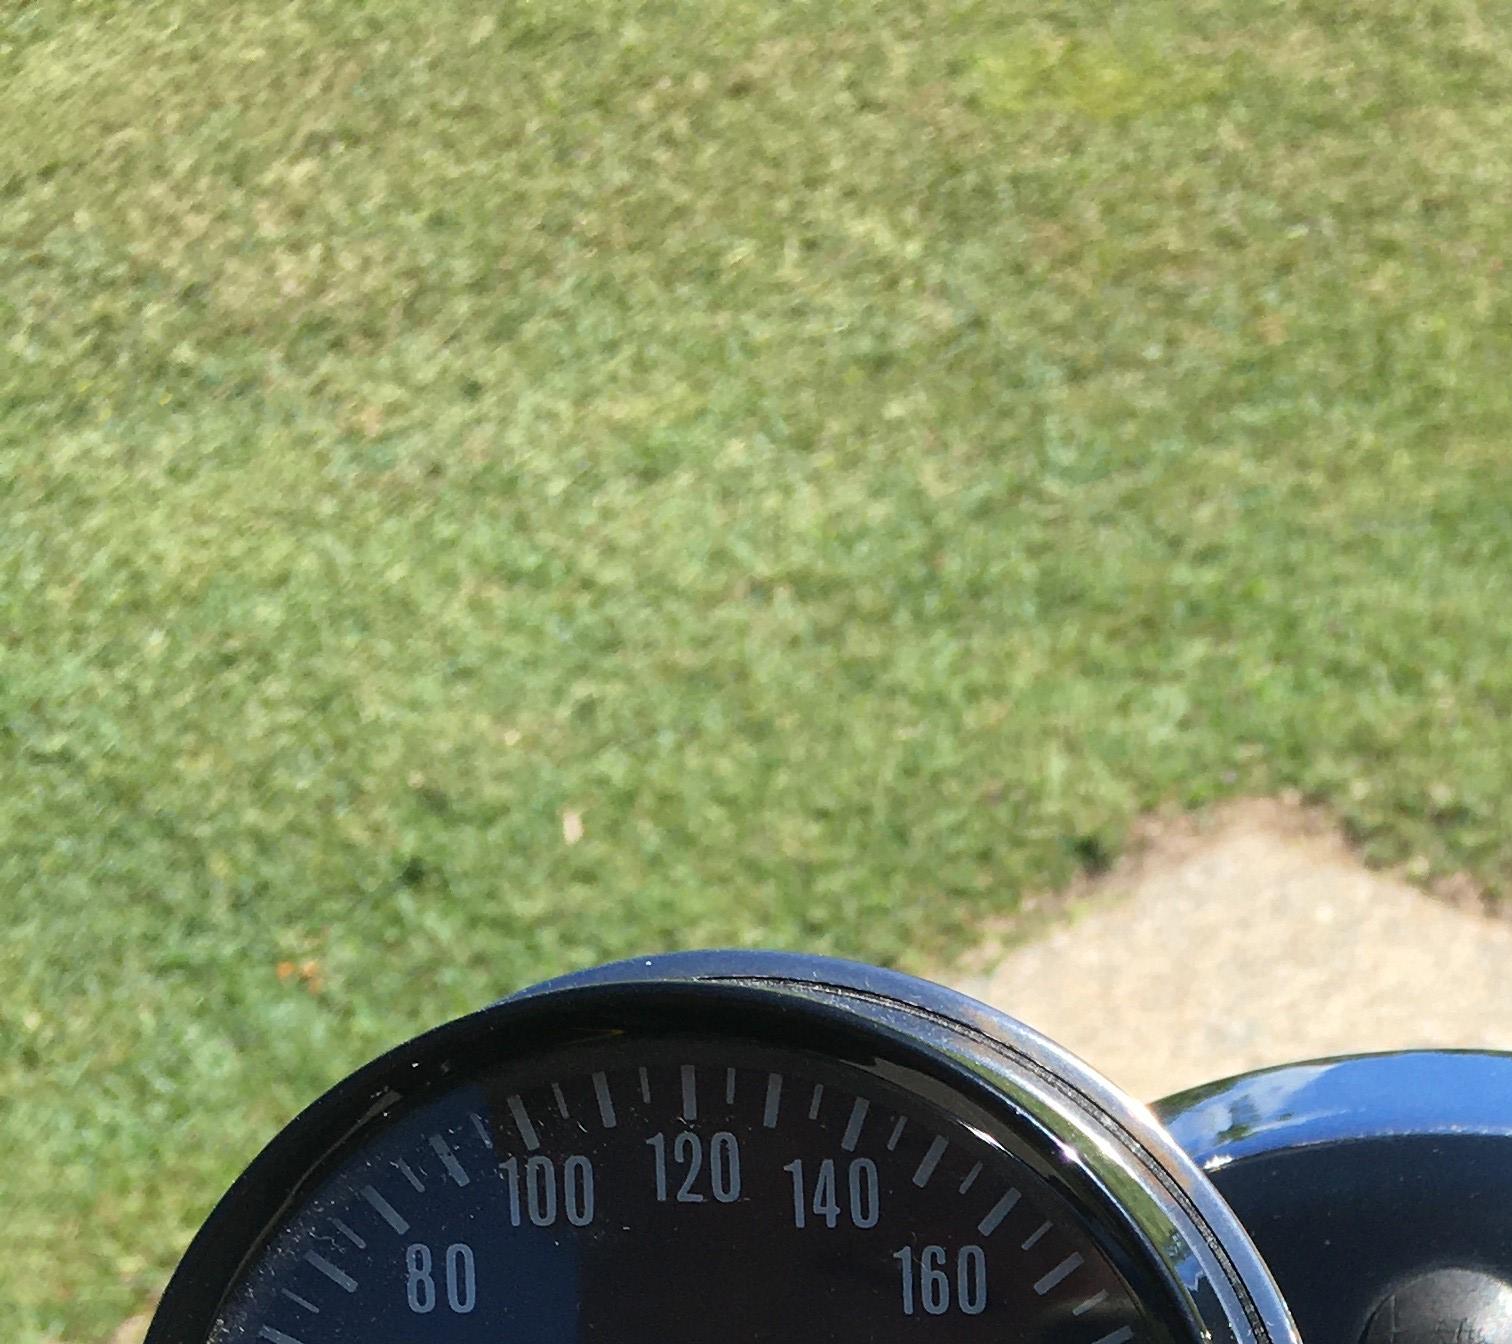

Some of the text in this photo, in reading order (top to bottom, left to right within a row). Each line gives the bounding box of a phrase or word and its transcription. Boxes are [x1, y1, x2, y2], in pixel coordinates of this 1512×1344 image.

[500, 1154, 596, 1228] 100
[645, 1131, 742, 1203] 120
[783, 1156, 880, 1229] 140
[405, 1243, 478, 1314] 80
[893, 1244, 988, 1316] 160
